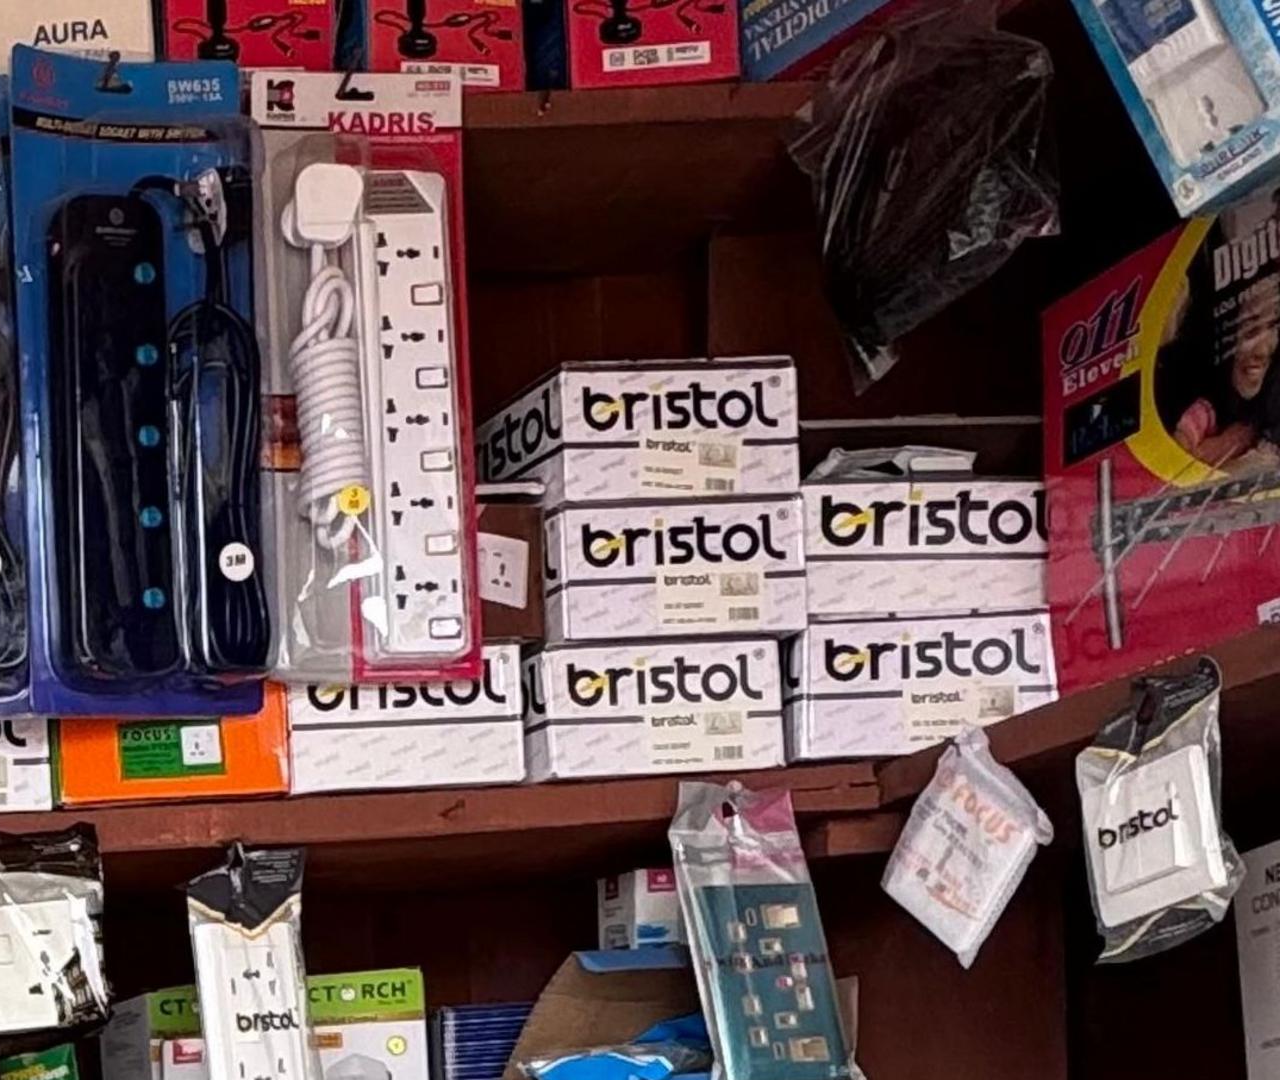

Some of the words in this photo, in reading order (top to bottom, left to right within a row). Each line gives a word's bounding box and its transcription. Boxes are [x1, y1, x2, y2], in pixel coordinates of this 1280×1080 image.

[33, 18, 109, 47] AURA
[327, 111, 436, 136] KADRIS
[582, 380, 778, 432] bristol
[580, 512, 786, 568] bristol
[821, 488, 1049, 547] bristol
[225, 553, 247, 569] 3M
[825, 628, 1040, 681] bristol
[566, 655, 763, 707] bristol
[1097, 798, 1179, 850] bristol
